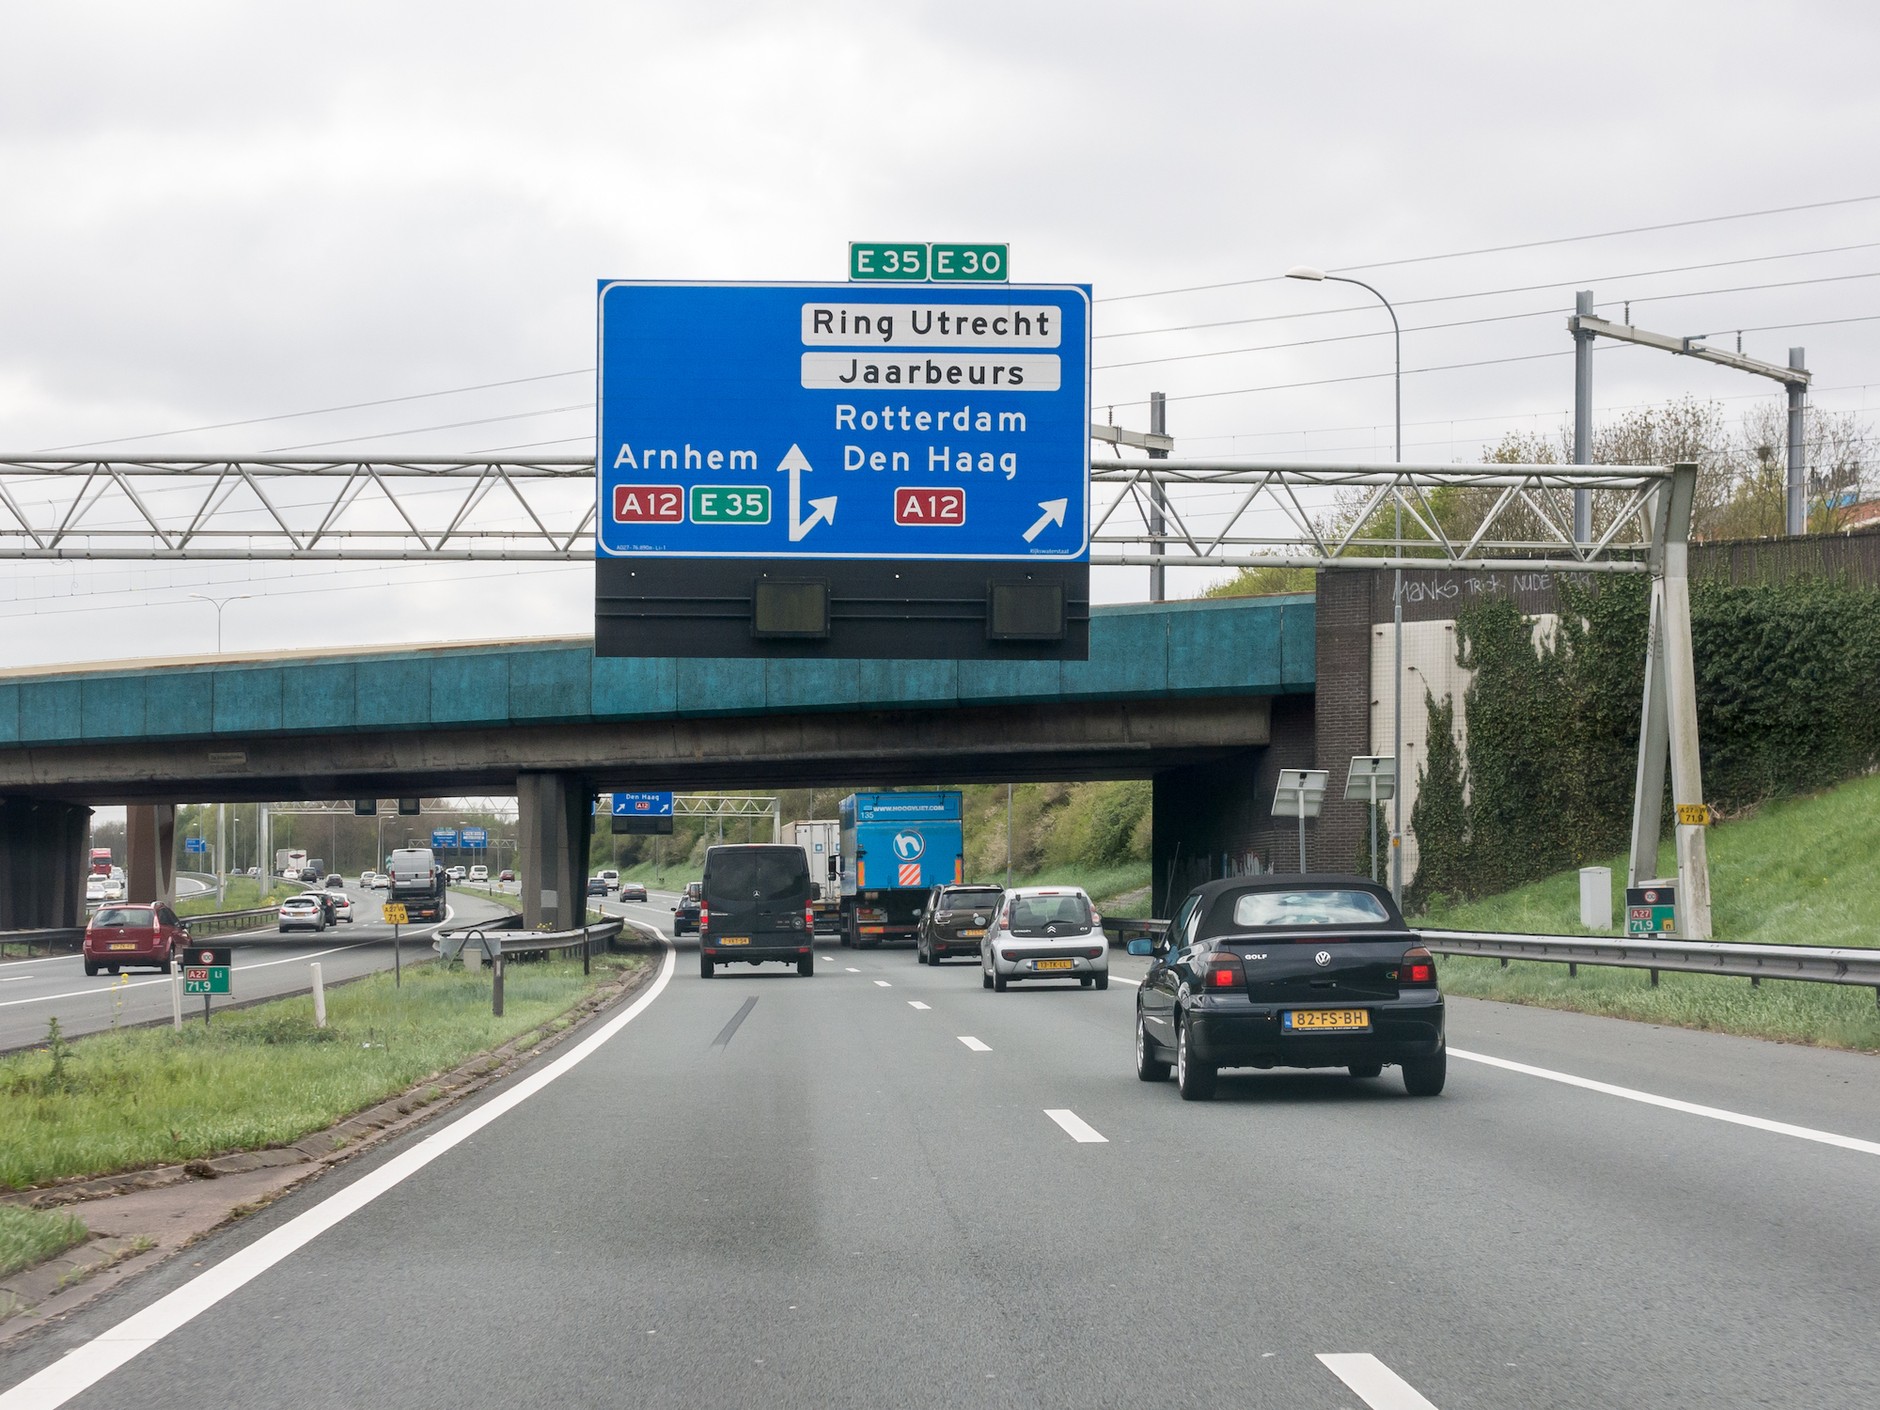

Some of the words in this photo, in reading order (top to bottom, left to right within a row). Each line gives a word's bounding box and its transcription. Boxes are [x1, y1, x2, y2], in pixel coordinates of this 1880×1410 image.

[858, 250, 875, 273] E
[882, 250, 920, 273] 35
[938, 251, 954, 273] E
[961, 251, 1000, 274] 30
[813, 309, 893, 343] Ring
[911, 310, 1049, 336] Utrecht
[839, 358, 1024, 385] Jaarbeurs
[835, 404, 1027, 432] Rotterdam
[613, 443, 758, 470] Arnhem
[844, 445, 910, 472] Den
[928, 446, 1017, 481] Haag
[621, 493, 678, 516] A12
[701, 493, 718, 516] E
[725, 493, 763, 516] 35
[902, 495, 959, 518] A12
[641, 793, 660, 801] Haag
[1631, 920, 1654, 931] 71,9
[1633, 910, 1650, 918] A27
[189, 970, 207, 978] A27
[214, 970, 223, 979] Li
[187, 981, 212, 992] 71,9
[1297, 1012, 1363, 1026] 82-FS-BH
